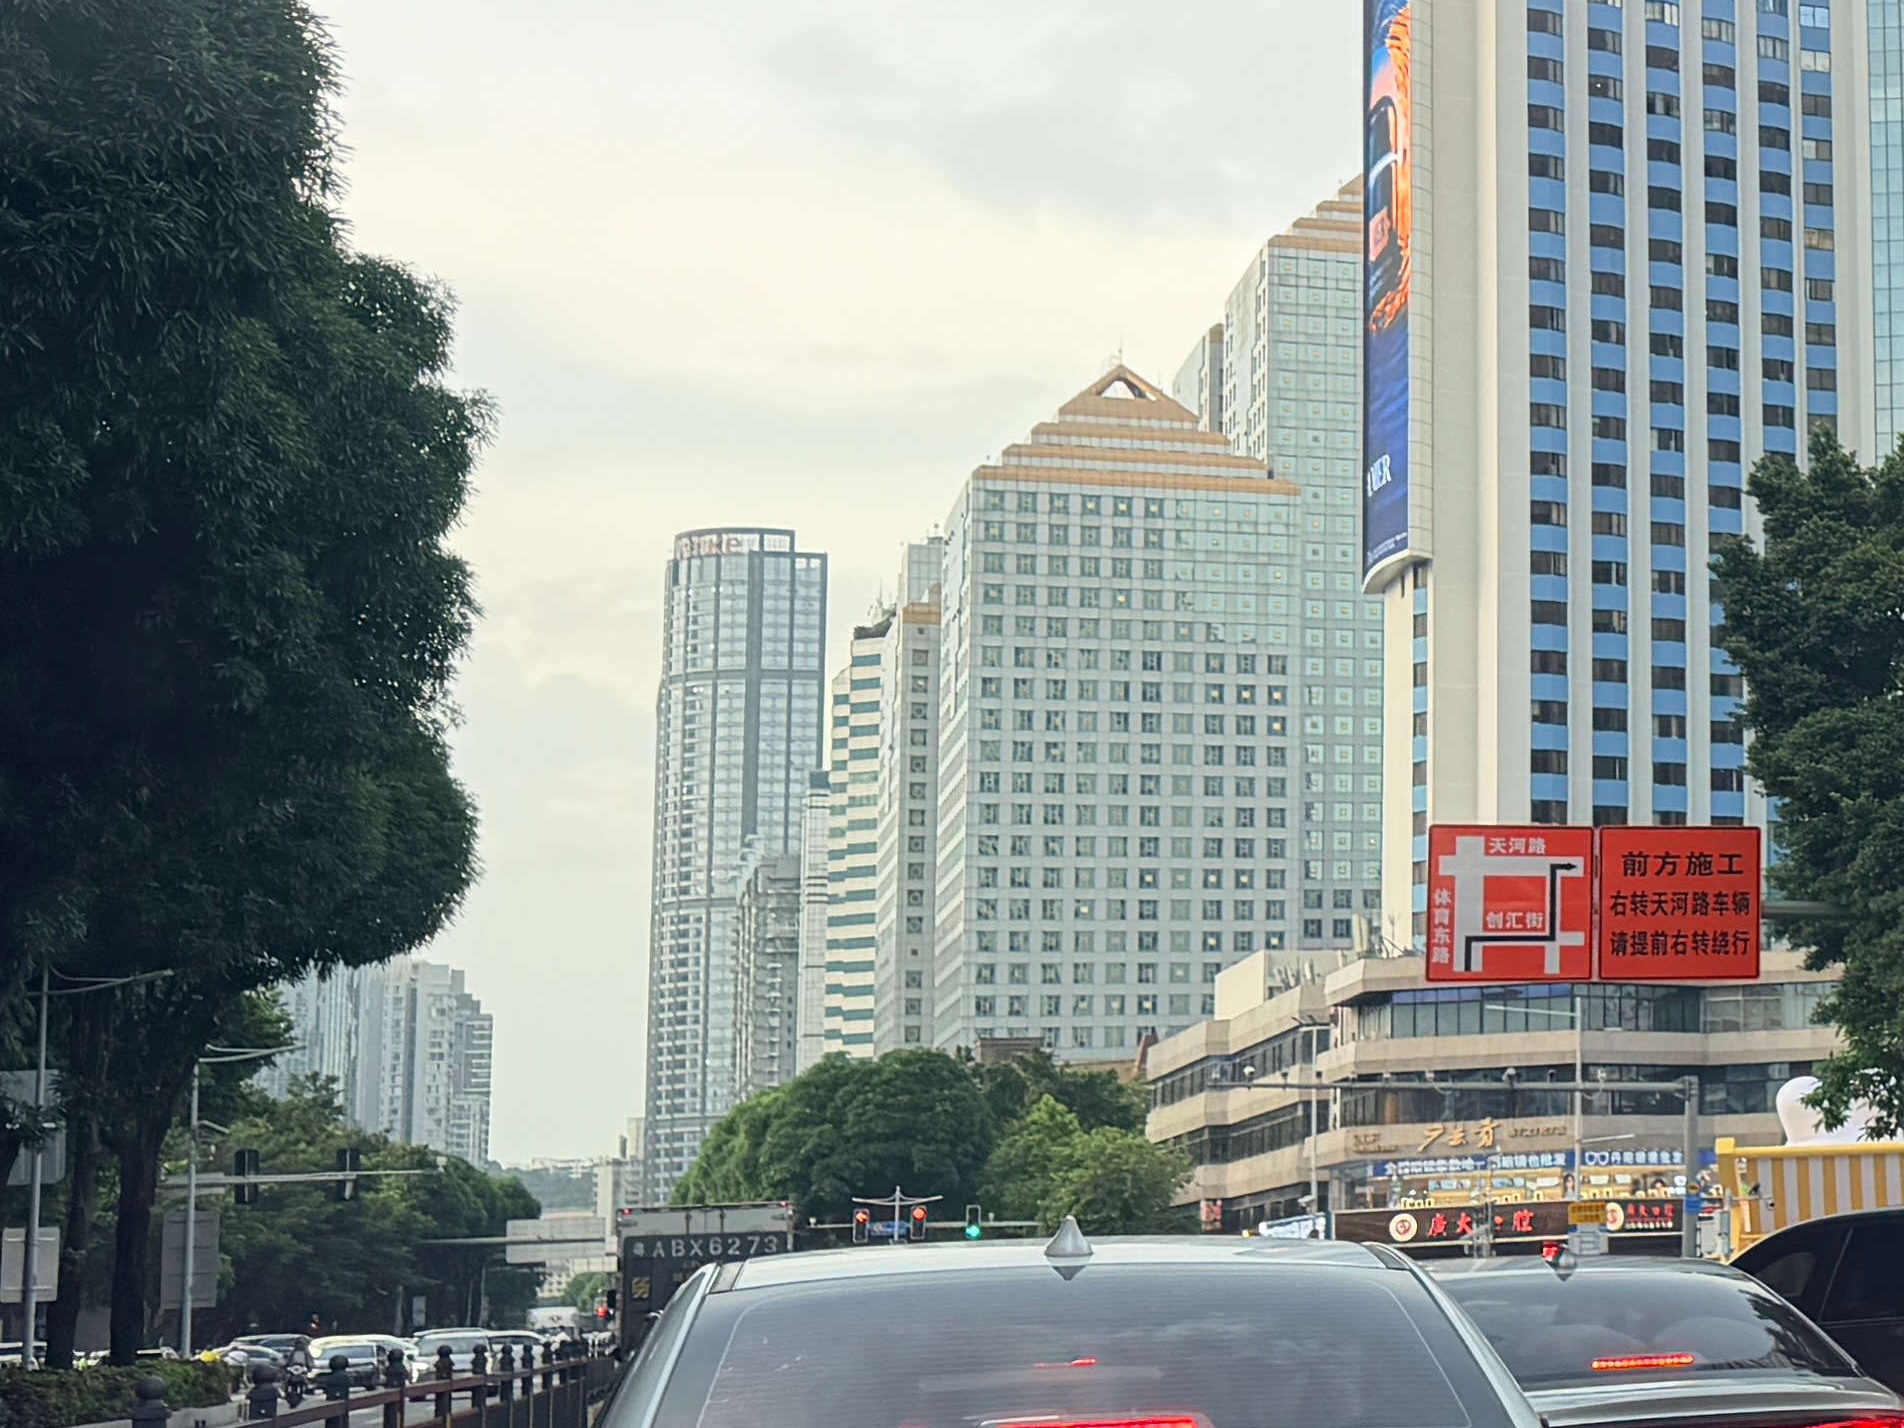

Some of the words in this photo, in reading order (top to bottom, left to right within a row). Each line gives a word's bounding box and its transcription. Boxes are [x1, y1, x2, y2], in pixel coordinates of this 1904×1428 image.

[1488, 837, 1546, 855] 天河路
[1621, 851, 1744, 877] 前方施工
[1610, 890, 1750, 917] 右转天河路车辆
[1431, 888, 1453, 964] 体育东路
[1486, 911, 1543, 930] 创汇街
[1610, 930, 1750, 957] 请提前右转绕行
